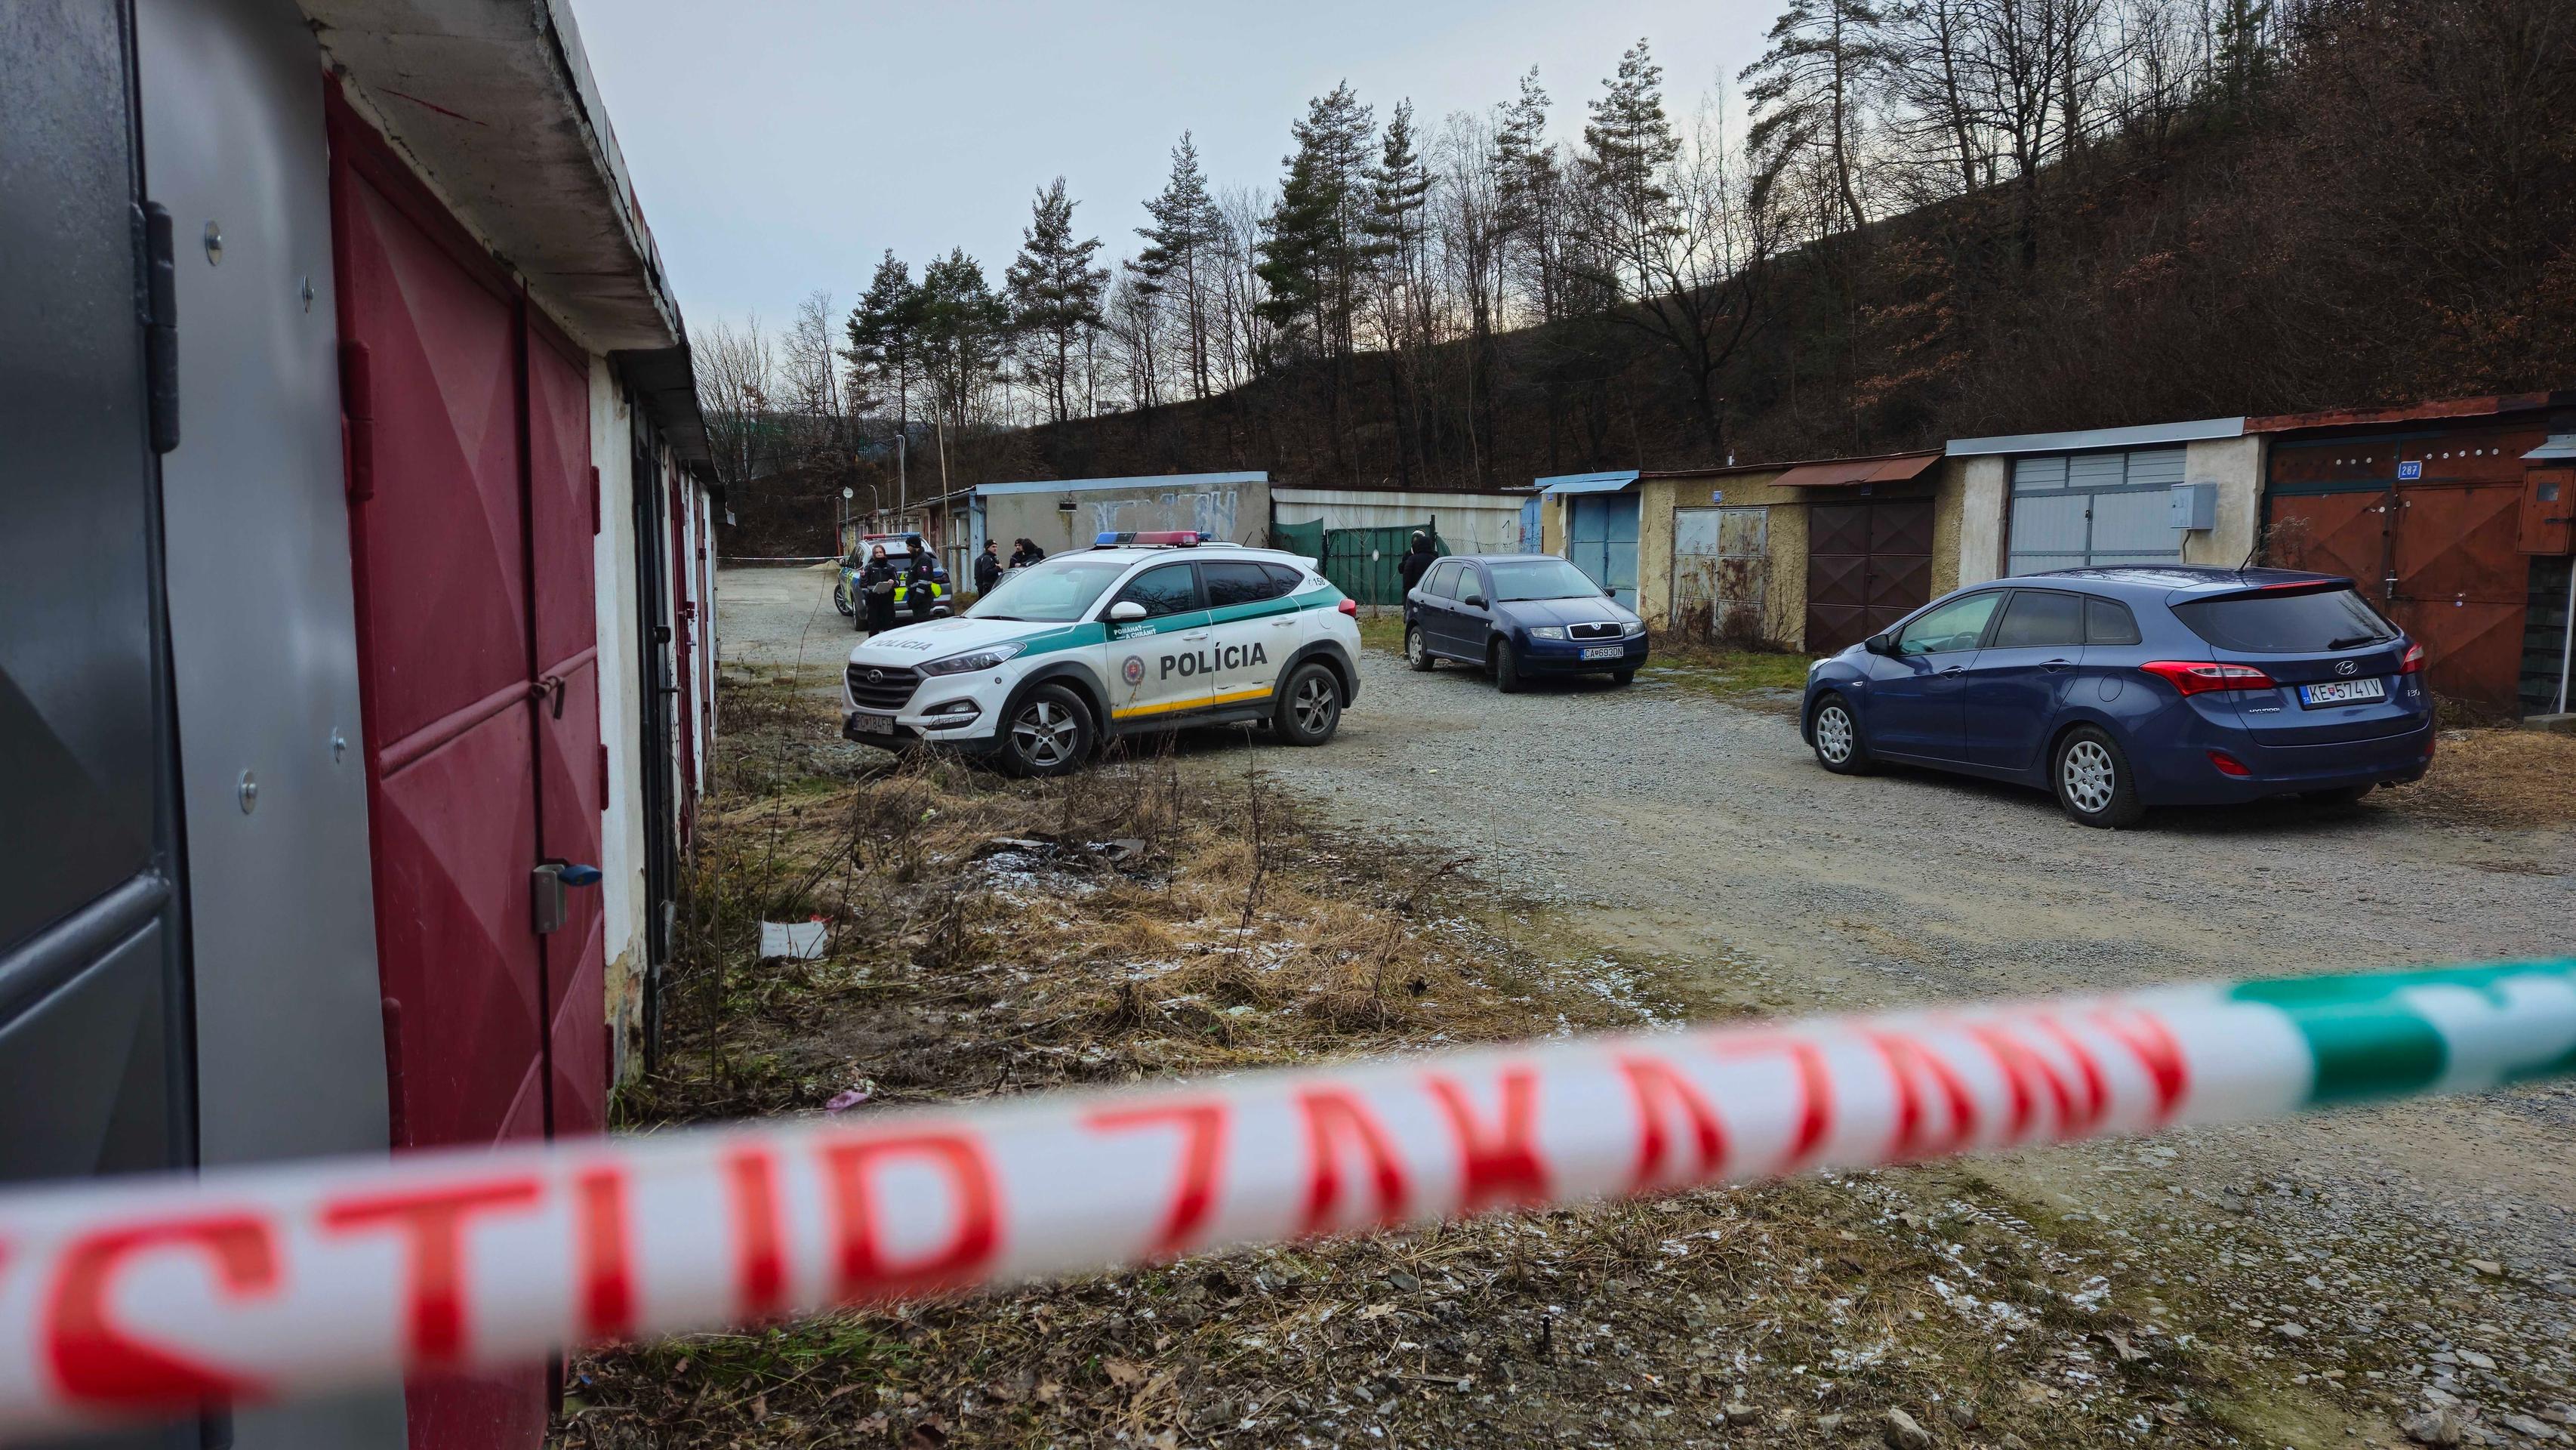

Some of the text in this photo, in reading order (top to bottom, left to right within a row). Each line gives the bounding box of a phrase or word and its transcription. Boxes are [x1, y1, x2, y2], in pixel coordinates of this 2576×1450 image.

[2402, 465, 2417, 476] 287
[1314, 577, 1326, 586] 158
[1160, 641, 1268, 680] POLÍCIA
[2407, 689, 2420, 697] i30
